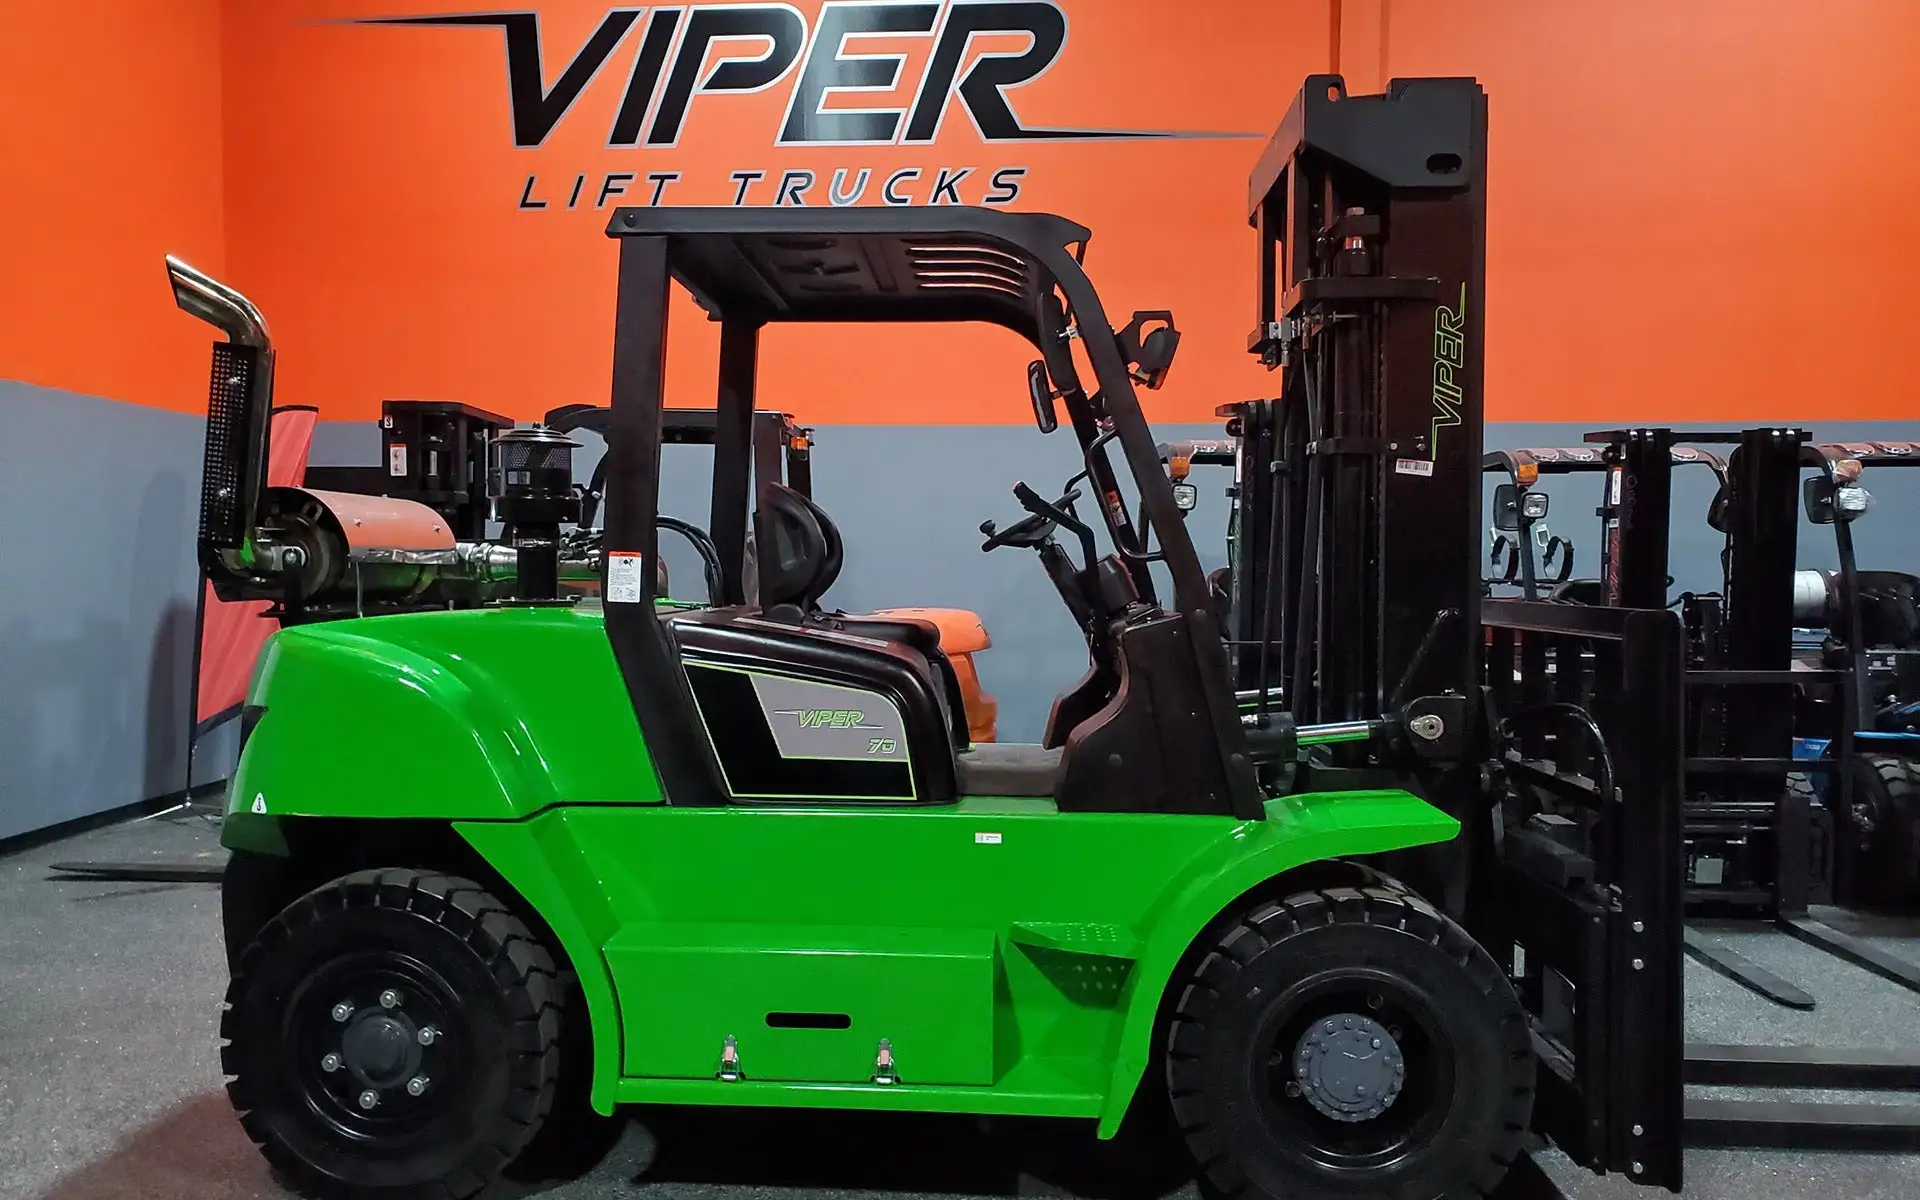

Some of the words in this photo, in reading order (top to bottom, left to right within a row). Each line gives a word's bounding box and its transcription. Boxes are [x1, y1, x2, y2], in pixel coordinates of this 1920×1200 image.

[335, 0, 1268, 149] VIPER
[517, 171, 682, 211] LIFT
[728, 167, 1028, 207] TRUCKS
[1431, 282, 1466, 461] VIPER
[773, 708, 884, 729] VIPER
[867, 738, 897, 753] 70
